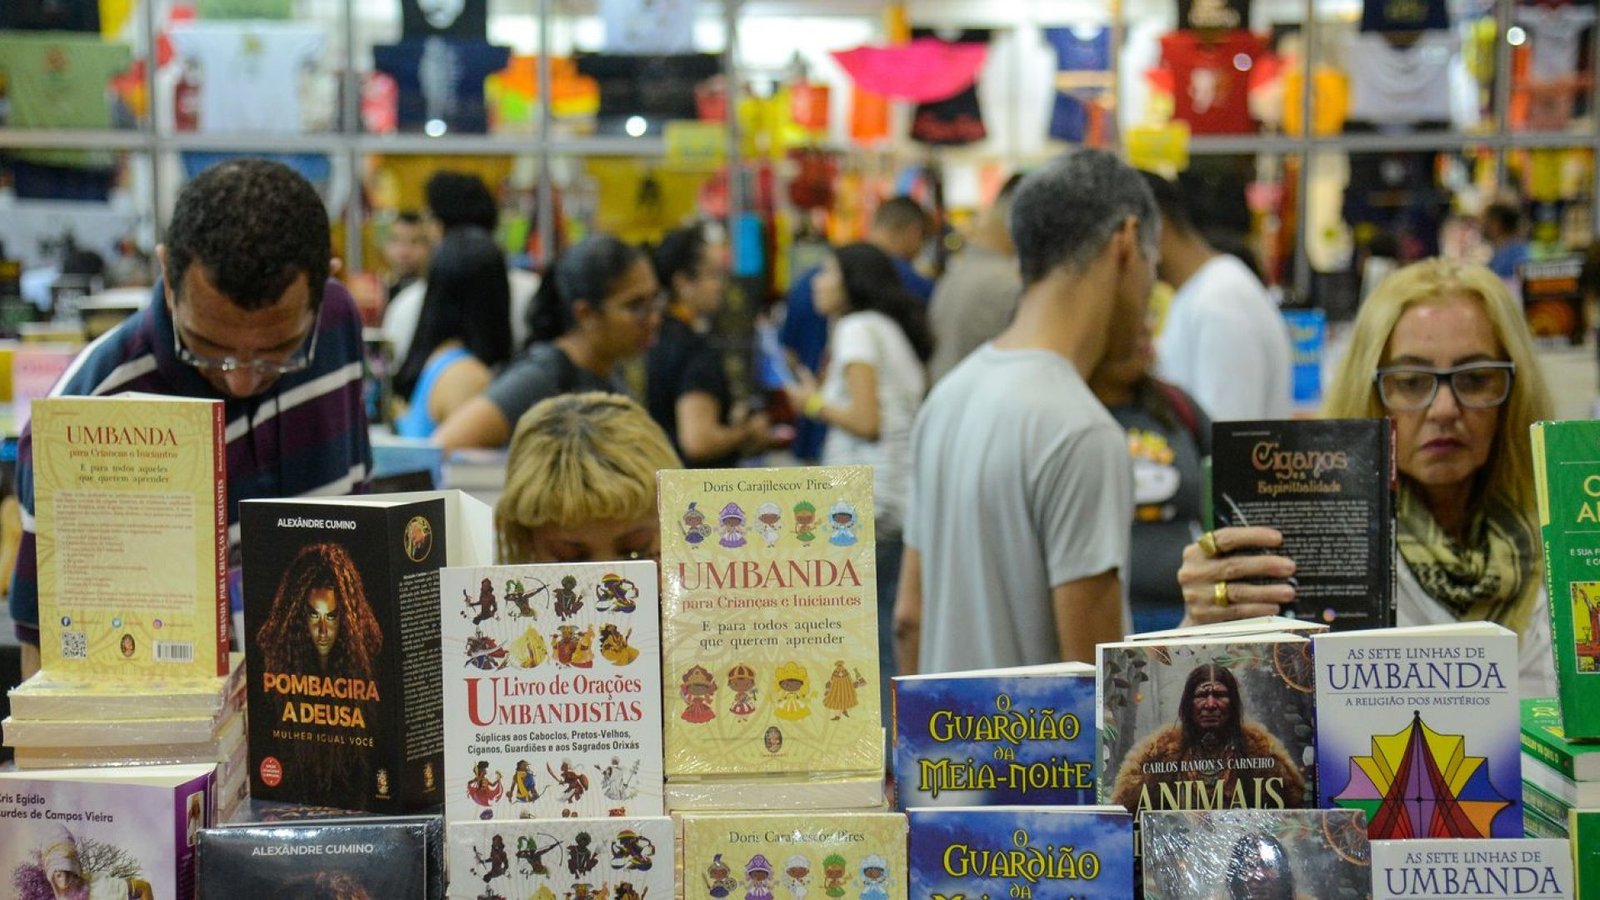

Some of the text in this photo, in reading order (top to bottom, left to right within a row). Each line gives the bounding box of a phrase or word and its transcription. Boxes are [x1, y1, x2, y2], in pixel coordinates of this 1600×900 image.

[66, 426, 178, 446] UMBANDA
[1252, 441, 1348, 479] Ciganos
[703, 478, 834, 493] Doris Carajilescov Pires
[325, 520, 356, 530] CUMINO
[1577, 548, 1594, 556] SUA
[678, 558, 862, 591] UMBANDA
[682, 594, 862, 612] para Crianças e Iniciantes
[702, 618, 842, 634] E para todos aqueles
[700, 634, 845, 650] que querem aprender
[1348, 648, 1486, 660] AS SETE LINHAS DE
[1326, 662, 1506, 690] UMBANDA
[263, 672, 380, 702] POMBAGIRA
[504, 674, 642, 700] Livro de Orações
[464, 676, 643, 727] UMBANDISTAS
[996, 694, 1011, 711] O
[1346, 696, 1490, 706] A RELIGIÃO DOS MISTÉRIOS
[282, 702, 366, 728] A DEUSA
[272, 730, 313, 741] MULHER
[317, 732, 345, 744] IGUAL
[476, 730, 632, 744] Súplicas aos Caboclos, Pretos-Velhos,
[468, 745, 502, 756] Ciganos,
[504, 744, 546, 754] Guardiões
[556, 743, 570, 751] aos
[572, 742, 611, 753] Sagrados
[612, 740, 640, 750] Orixás
[1142, 757, 1275, 774] CARLOS RAMON S. CARNEIRO
[1134, 776, 1286, 823] ANIMAIS
[30, 809, 42, 819] de
[45, 810, 82, 822] Campos
[85, 811, 114, 822] Vieira
[1013, 829, 1028, 848] O
[326, 844, 374, 854] CUMINO
[1405, 851, 1542, 864] AS SETE LINHAS DE
[1384, 867, 1562, 896] UMBANDA
